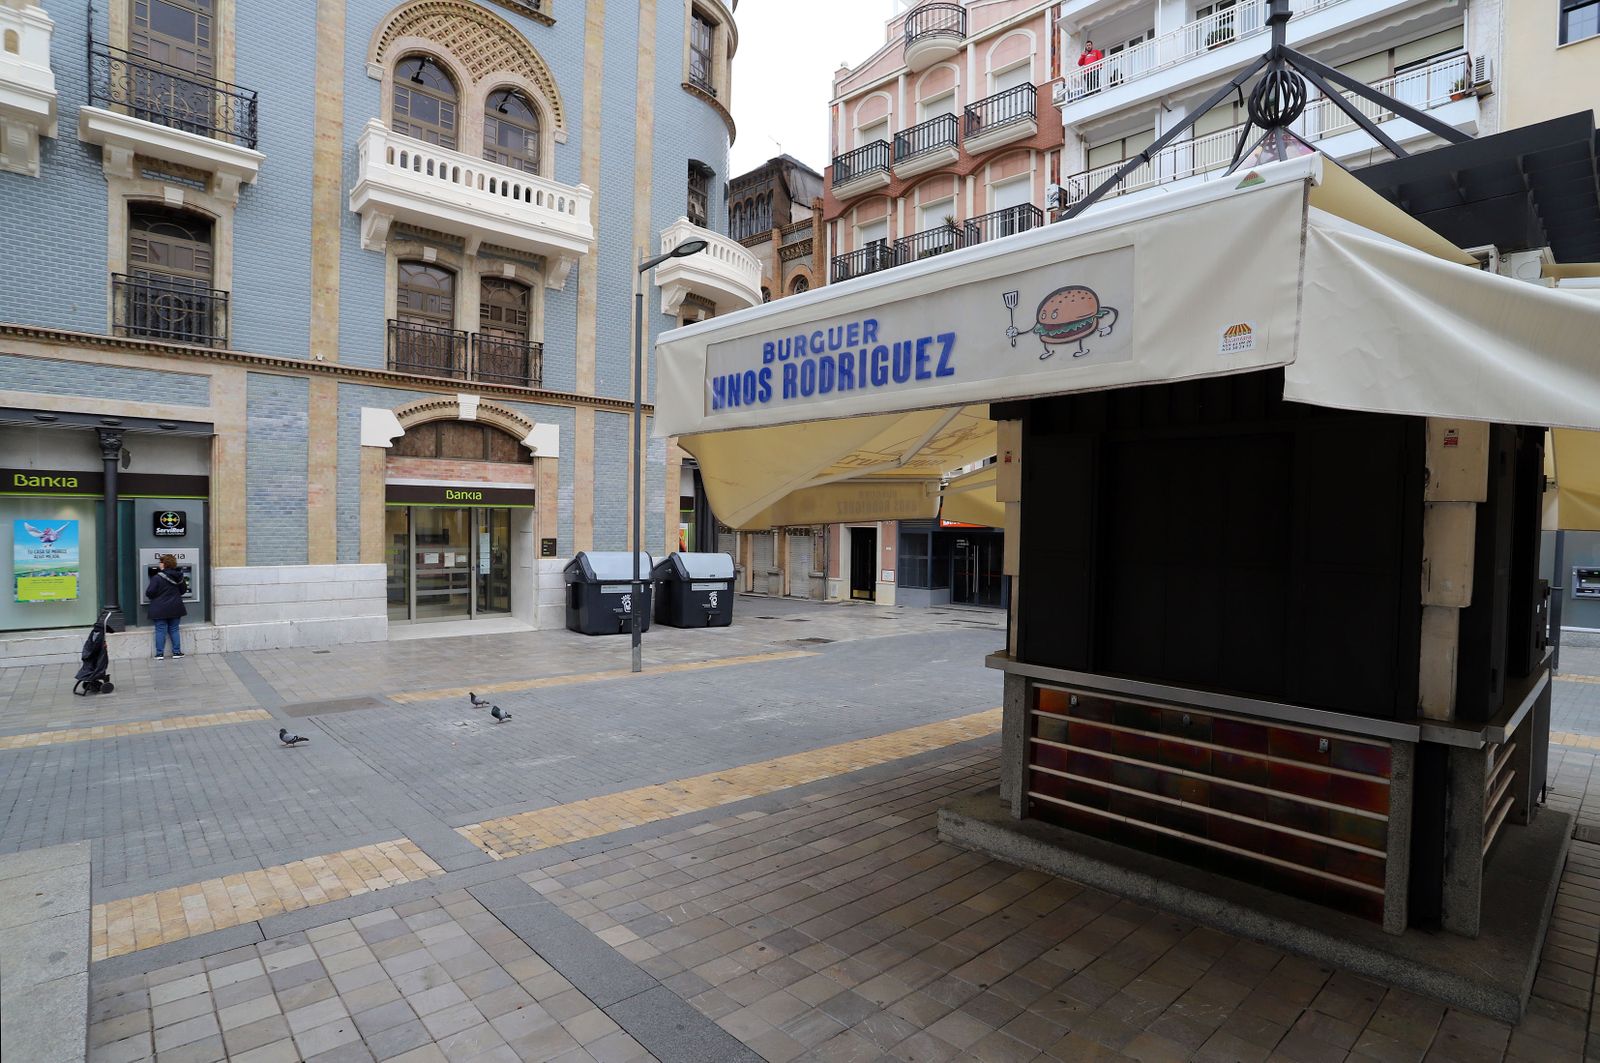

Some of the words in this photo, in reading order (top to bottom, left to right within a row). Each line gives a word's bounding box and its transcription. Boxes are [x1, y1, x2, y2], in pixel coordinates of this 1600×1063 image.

[763, 318, 878, 364] BURGUER
[712, 367, 772, 410] HNOS
[783, 332, 956, 399] RODRIGUEZ
[14, 473, 79, 488] Bankia
[446, 489, 482, 500] Bankia
